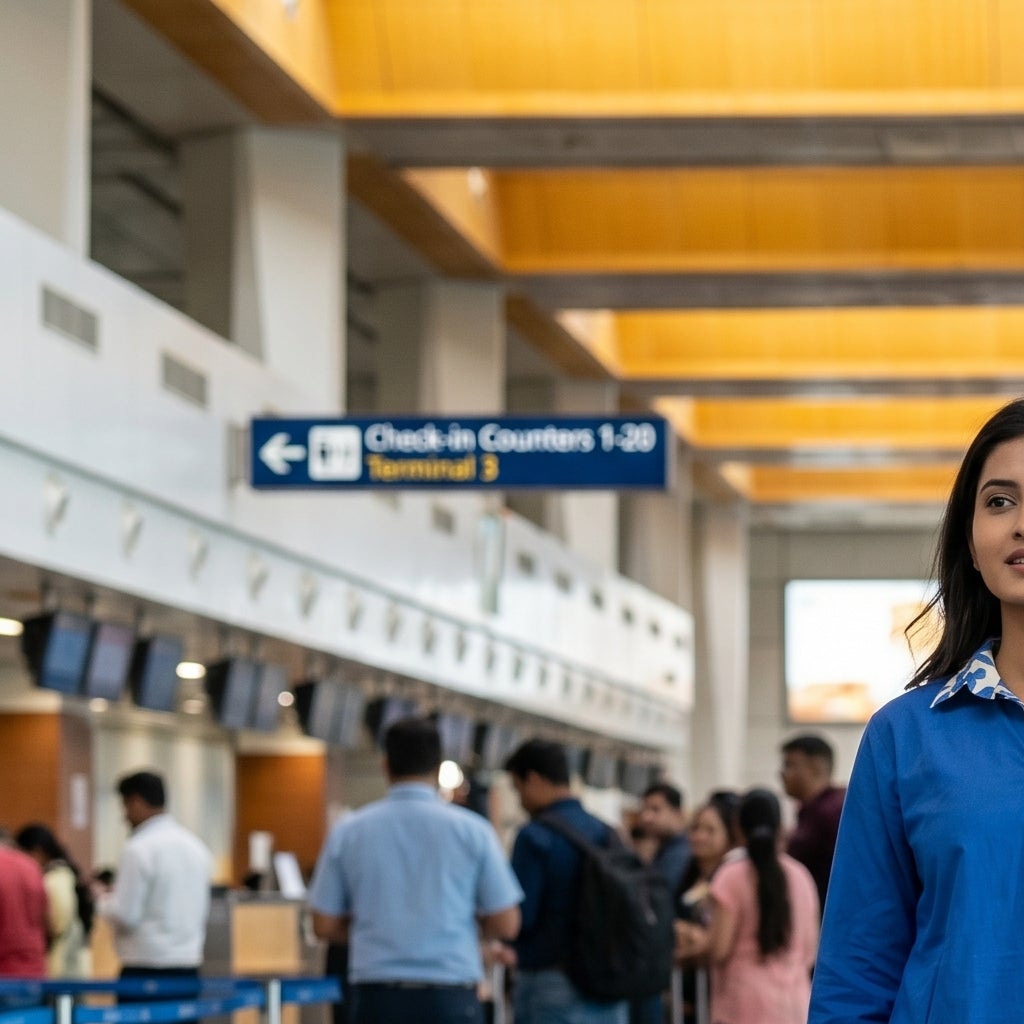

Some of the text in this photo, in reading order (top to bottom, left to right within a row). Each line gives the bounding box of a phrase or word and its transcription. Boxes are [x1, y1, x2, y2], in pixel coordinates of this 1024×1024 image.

[364, 422, 476, 453] Check-in
[478, 423, 596, 453] Counters
[366, 453, 499, 482] Terminal 3
